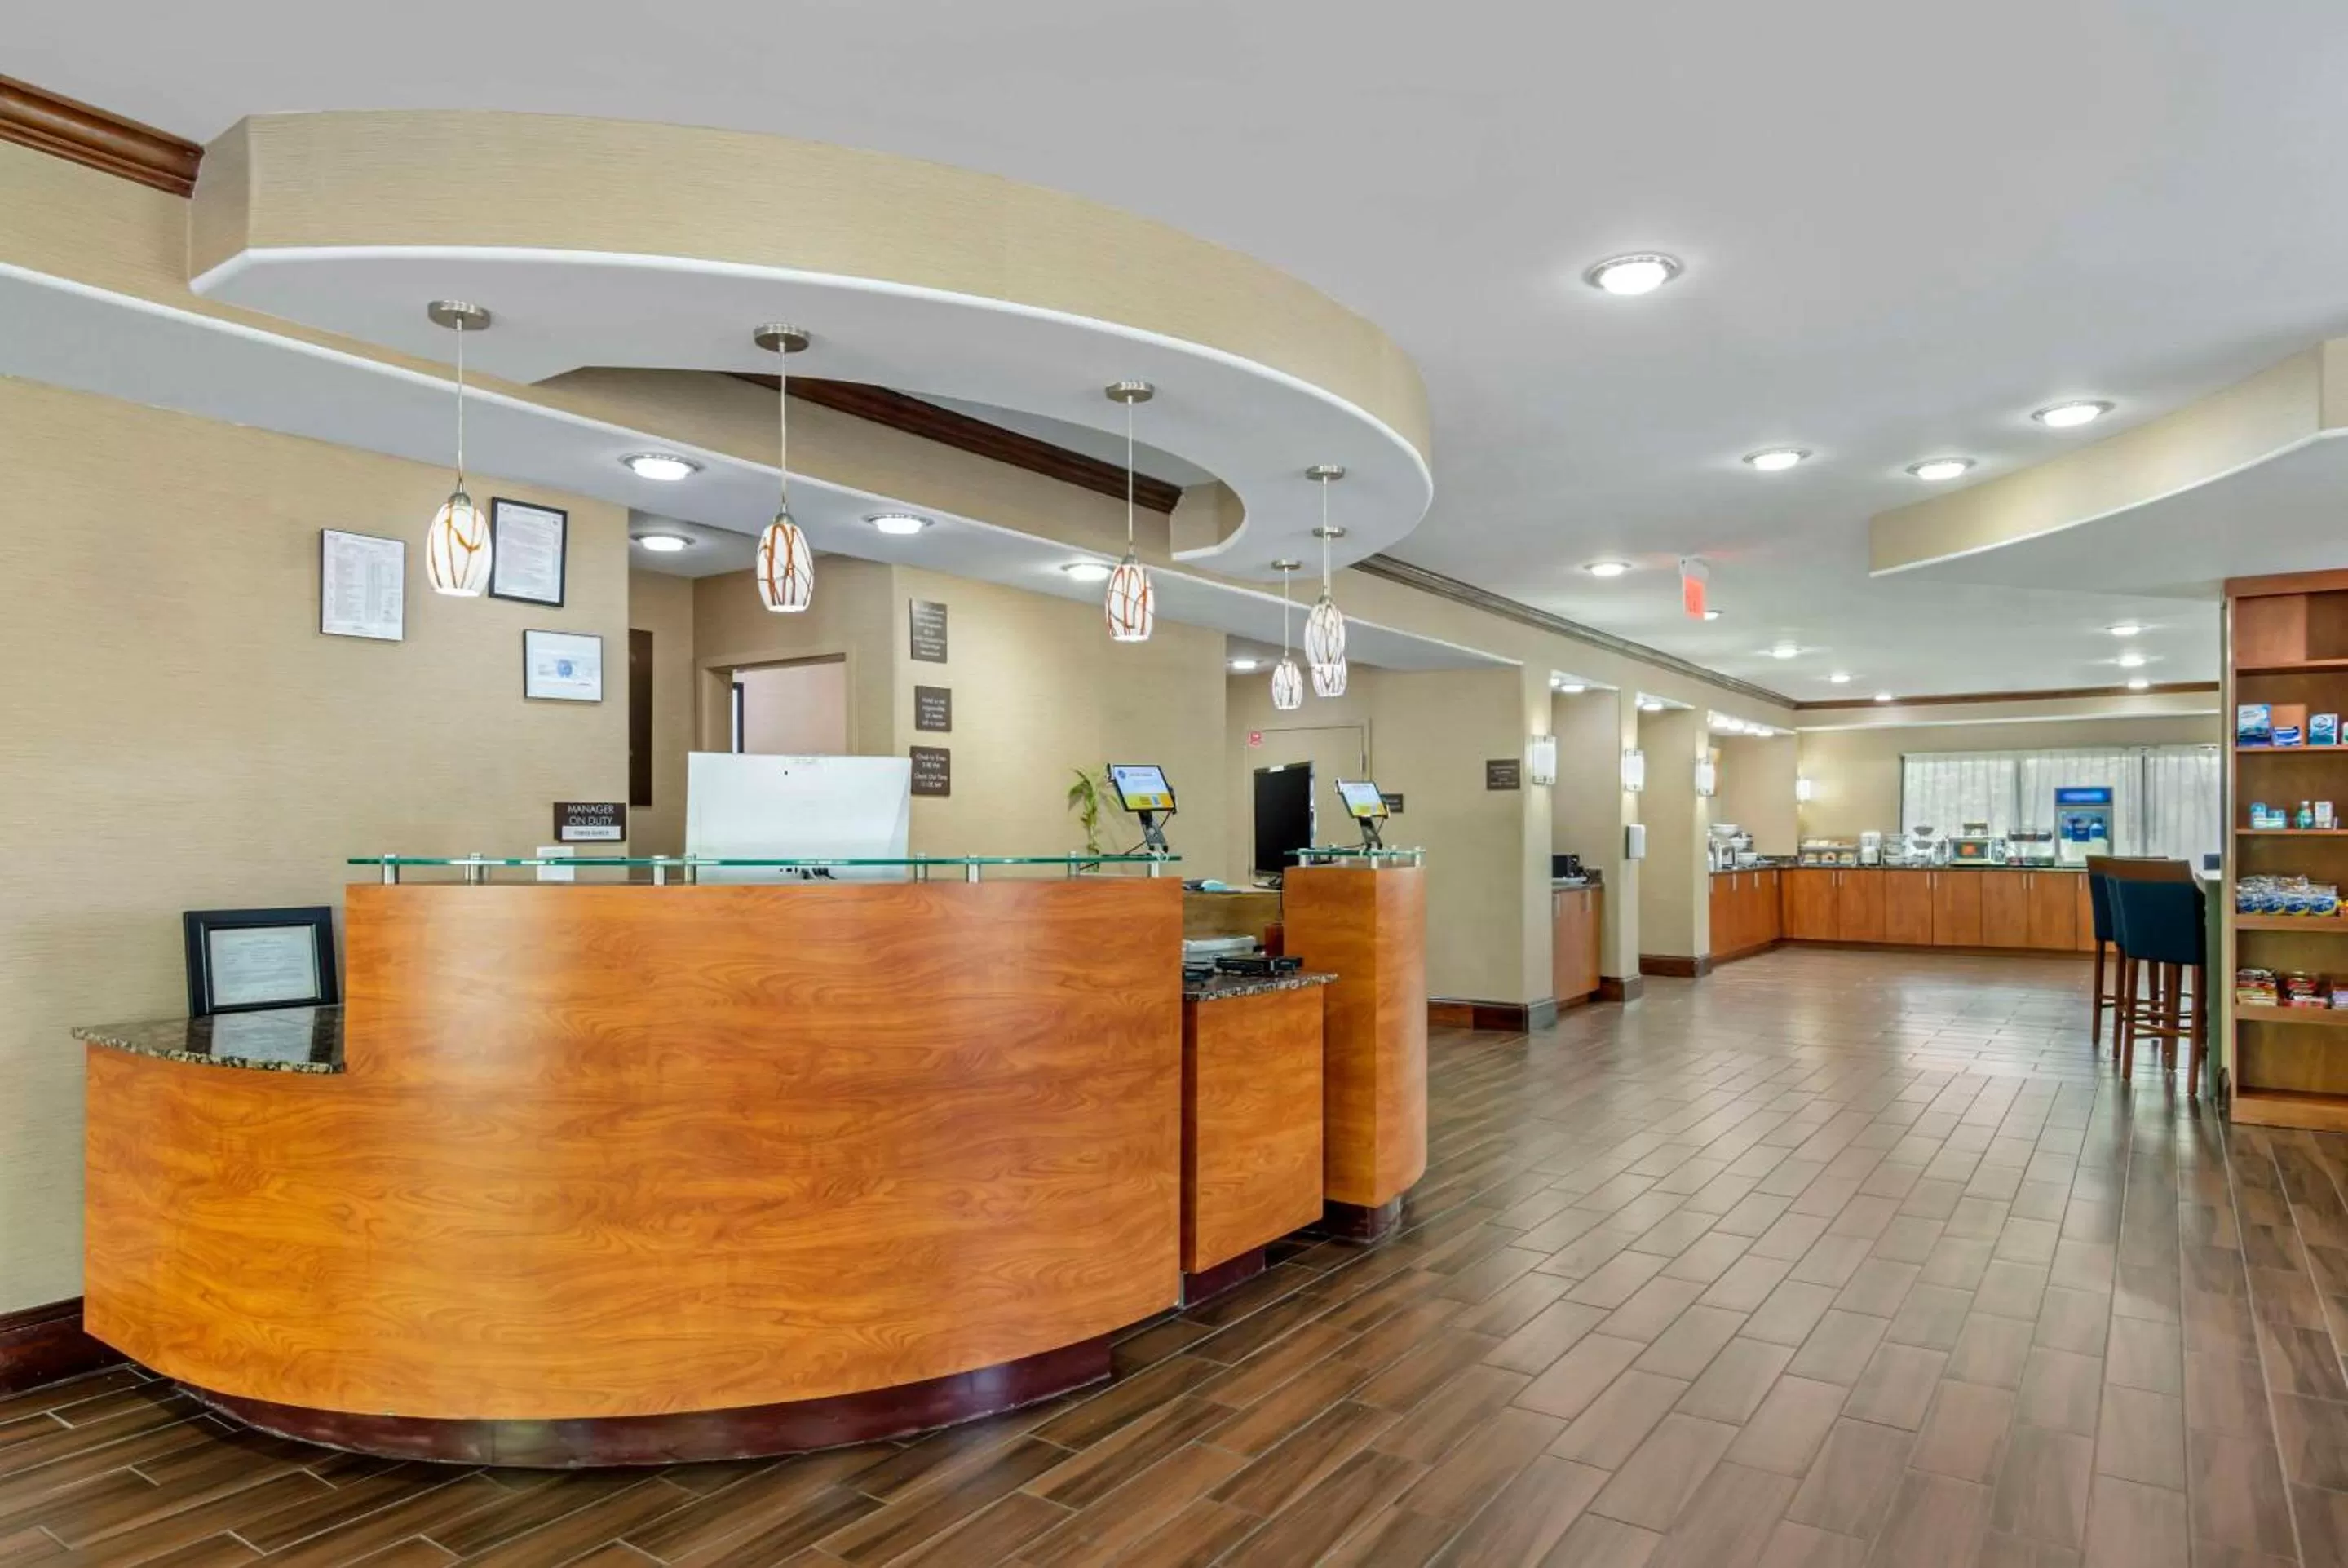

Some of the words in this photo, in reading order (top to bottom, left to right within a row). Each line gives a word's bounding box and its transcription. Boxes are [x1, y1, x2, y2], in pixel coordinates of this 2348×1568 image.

[568, 804, 614, 815] MANAGER
[569, 815, 586, 825] ON
[588, 816, 613, 826] DUTY
